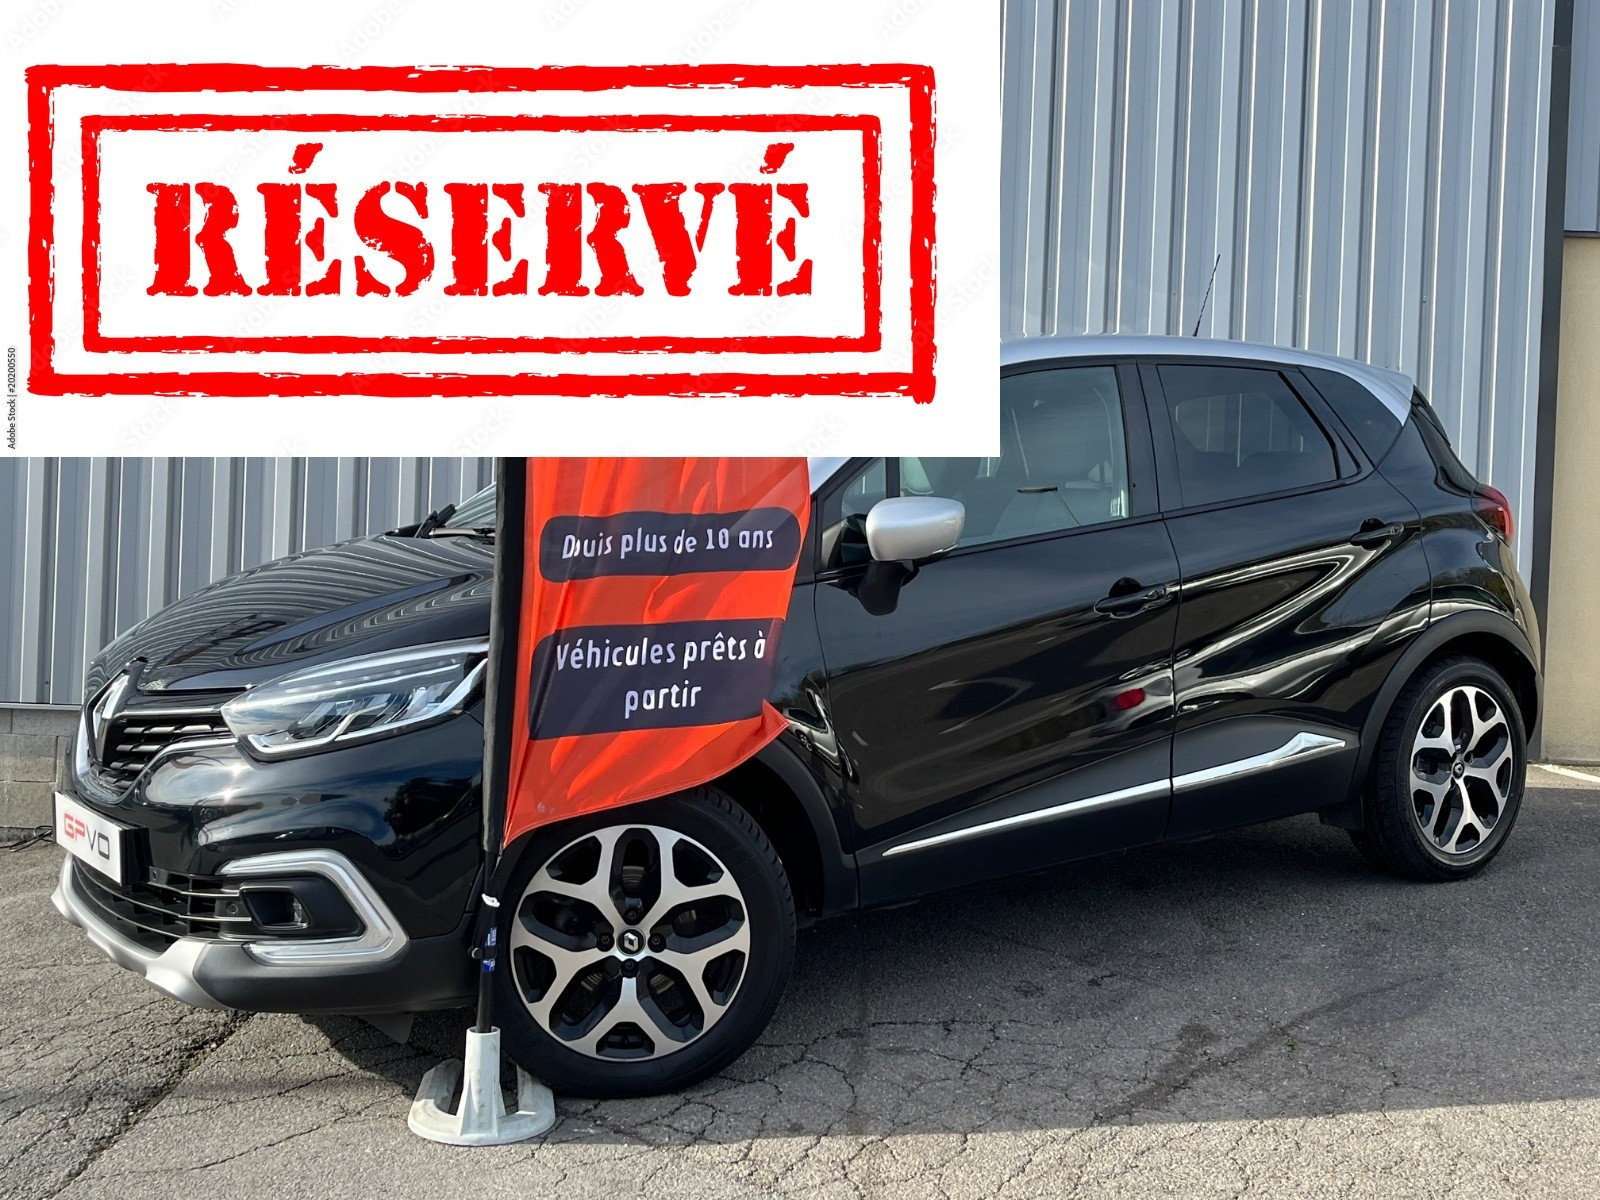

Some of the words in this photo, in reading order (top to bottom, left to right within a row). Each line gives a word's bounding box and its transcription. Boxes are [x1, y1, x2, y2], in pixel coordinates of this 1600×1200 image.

[620, 527, 668, 560] plus
[673, 528, 697, 554] de
[706, 528, 729, 550] 10
[738, 529, 774, 549] ans
[556, 636, 676, 671] Véhicules
[683, 631, 747, 670] prêts
[753, 629, 766, 659] à
[624, 678, 702, 719] partir
[64, 813, 110, 860] GPVO
